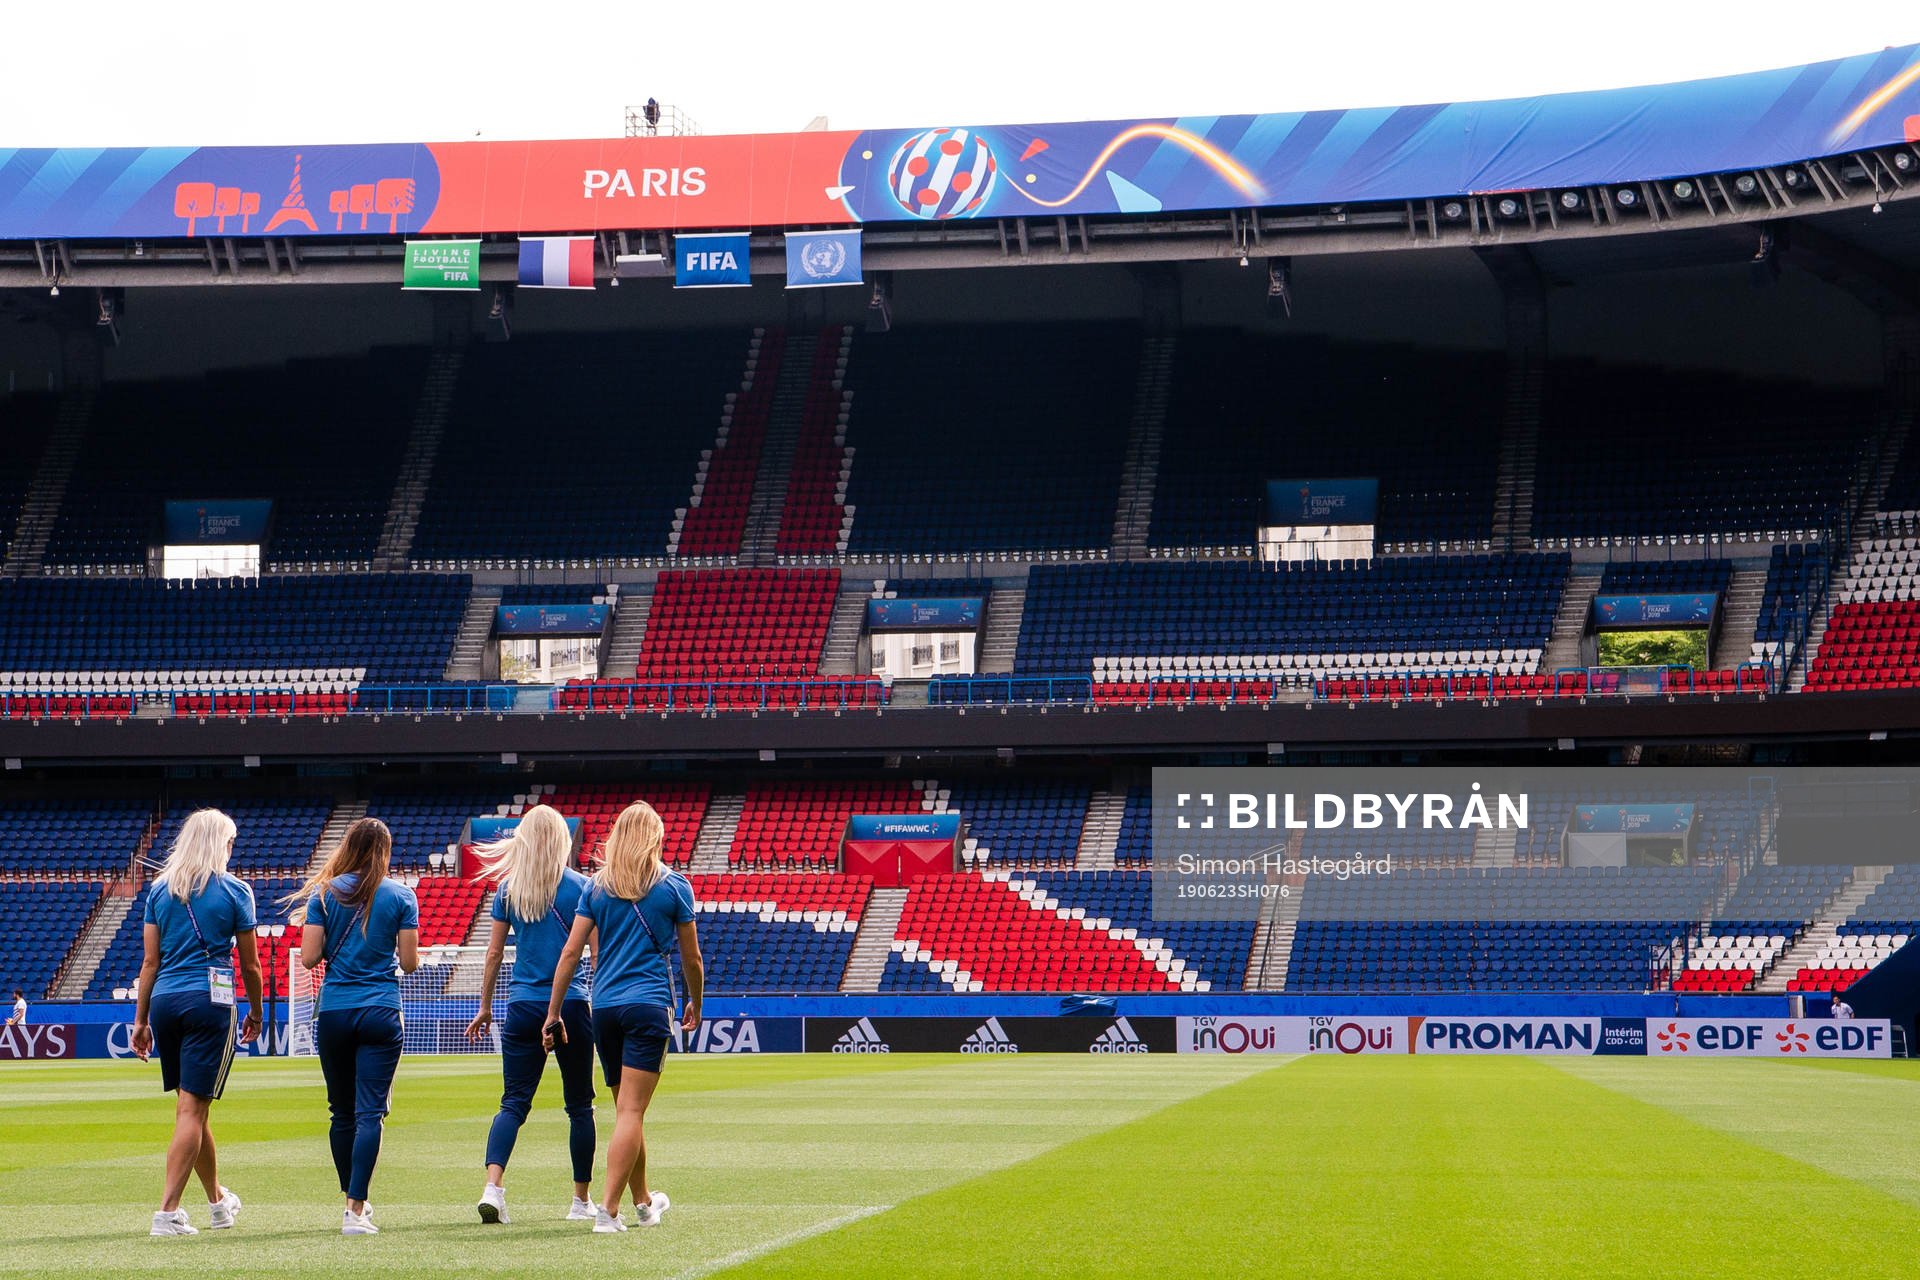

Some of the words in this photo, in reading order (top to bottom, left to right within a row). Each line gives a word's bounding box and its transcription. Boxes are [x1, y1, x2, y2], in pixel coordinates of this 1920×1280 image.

[583, 167, 707, 199] PARIS
[413, 256, 470, 264] FOOTBALL
[686, 252, 738, 271] FIFA
[444, 272, 469, 281] FIFA
[884, 825, 930, 833] #FIFAWWC
[1193, 1017, 1217, 1026] TGV
[1309, 1017, 1333, 1026] TGV
[673, 1020, 760, 1053] VISA
[1426, 1023, 1592, 1049] PROMAN
[1605, 1027, 1643, 1037] Intérim
[832, 1040, 890, 1054] adidas
[960, 1040, 1018, 1054] adidas
[1089, 1040, 1149, 1054] adidas
